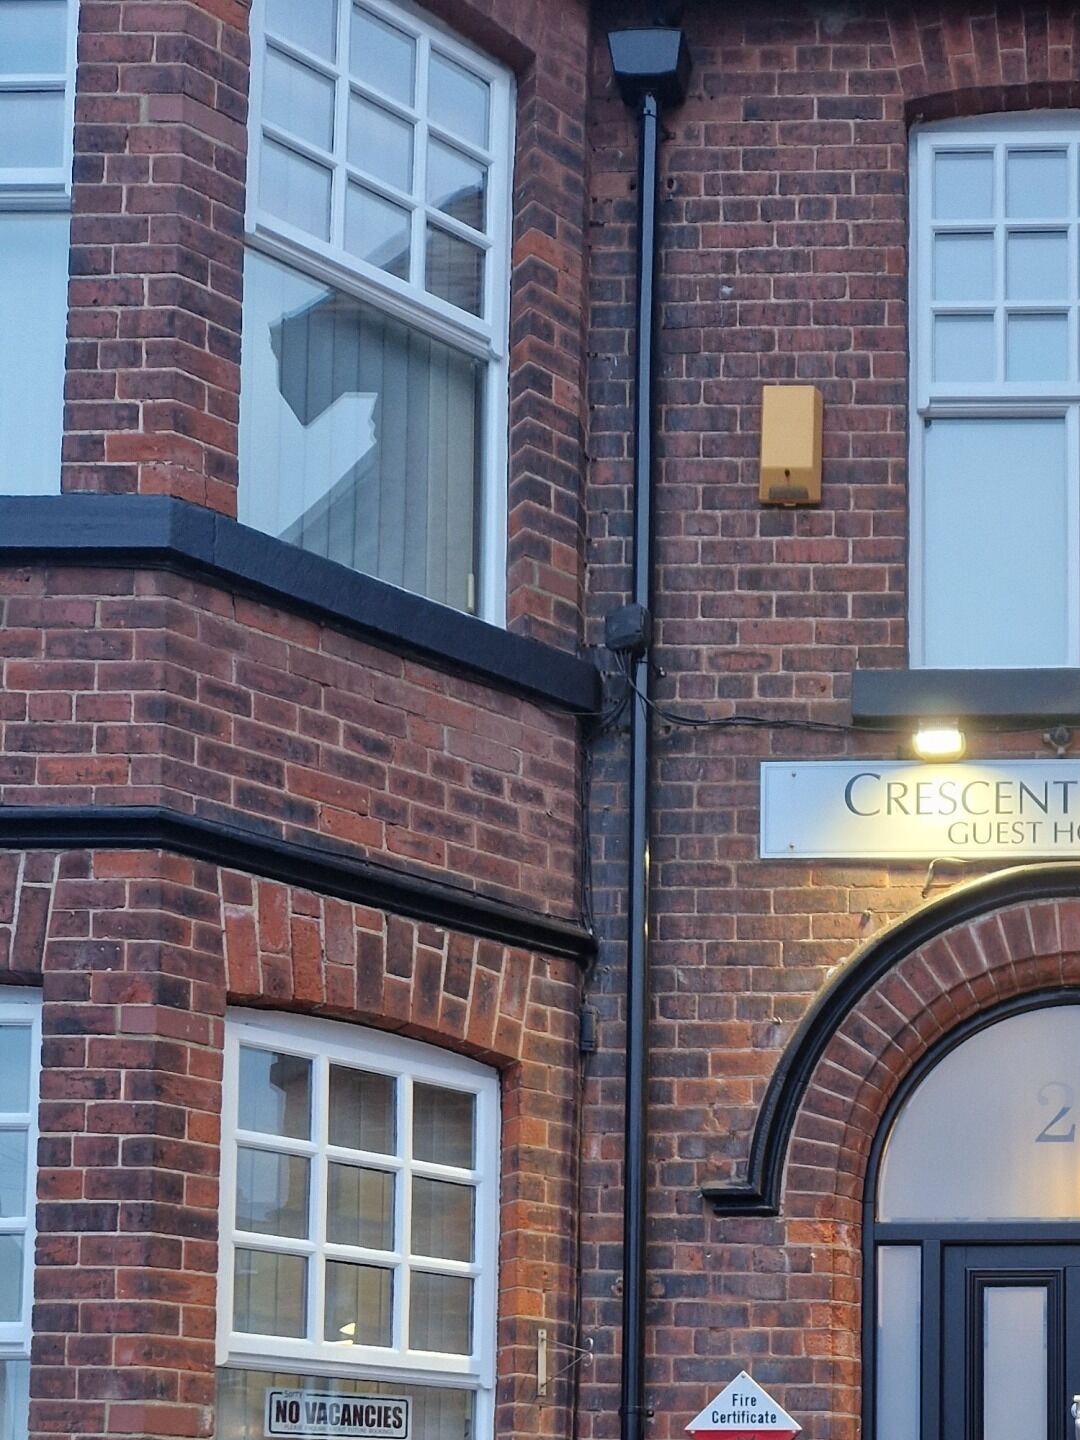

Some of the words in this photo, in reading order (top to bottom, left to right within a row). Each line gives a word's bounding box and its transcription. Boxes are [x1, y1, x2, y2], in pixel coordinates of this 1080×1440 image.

[843, 771, 1079, 817] CRESCENT
[946, 821, 1044, 845] GUEST
[732, 1393, 757, 1407] Fire
[275, 1400, 300, 1424] NO
[304, 1401, 403, 1429] VACANCIES
[711, 1410, 777, 1425] Certificate
